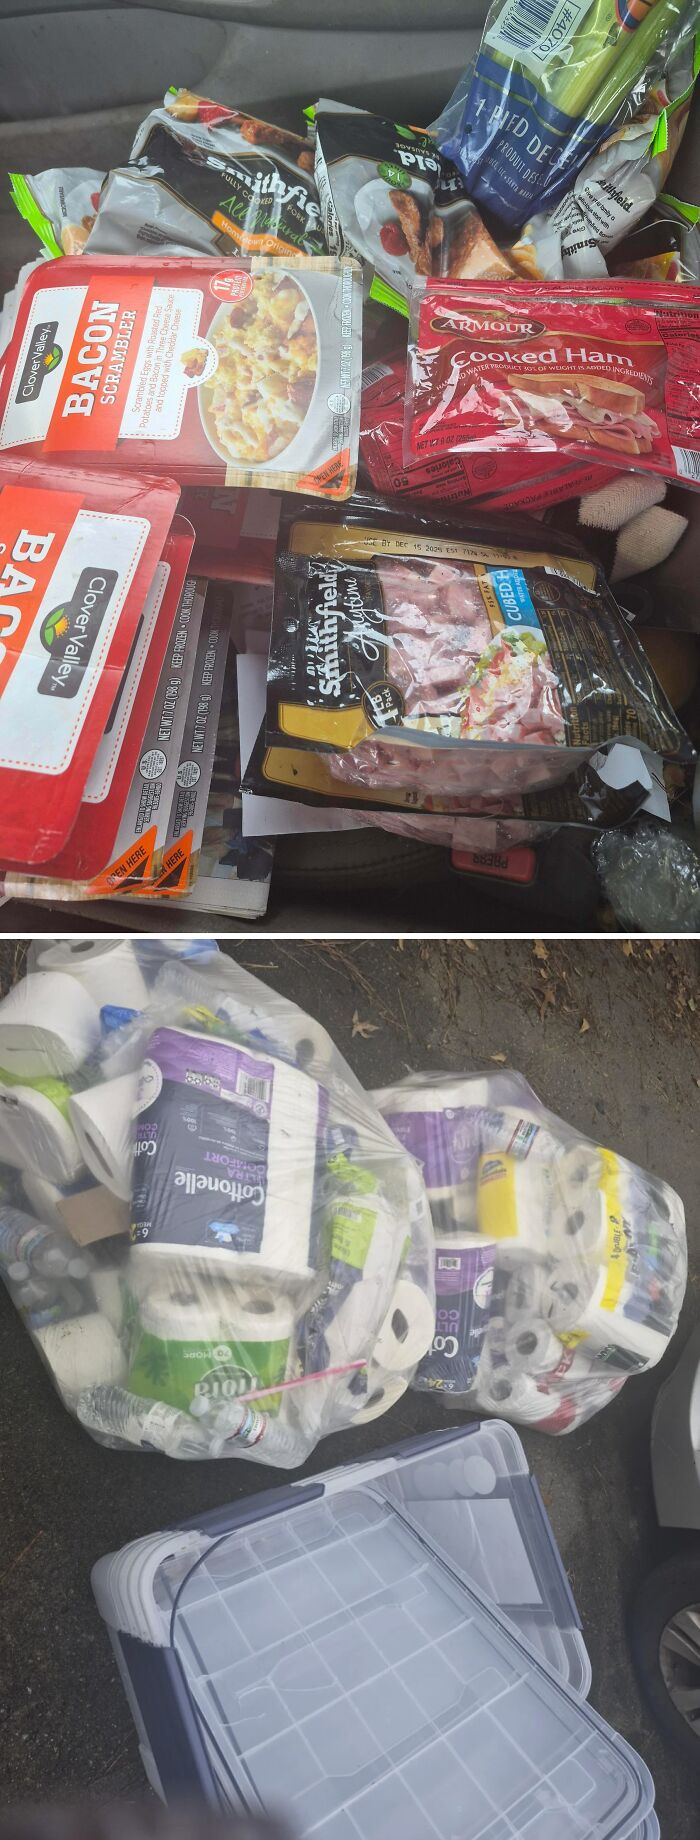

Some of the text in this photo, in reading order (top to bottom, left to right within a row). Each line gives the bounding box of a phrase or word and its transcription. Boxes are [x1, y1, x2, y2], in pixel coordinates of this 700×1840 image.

[538, 8, 573, 52] #4070
[475, 99, 553, 164] 1 PIED DE
[496, 140, 526, 172] PRODUIT
[221, 172, 242, 191] FULLY
[286, 203, 306, 224] PORK
[596, 179, 634, 214] ithfield
[656, 310, 700, 319] Nutrition
[440, 319, 536, 335] ARMOUR
[145, 345, 154, 359] with
[156, 336, 166, 354] Three
[22, 327, 52, 397] CloverValley
[61, 300, 120, 418] BACON
[100, 310, 137, 405] SCRAMBLER
[141, 358, 152, 375] Eggs
[155, 308, 182, 412] and topped with Cheddar Cheese
[450, 347, 634, 370] Cooked Ham
[150, 361, 161, 382] Bacon
[466, 363, 491, 375] WATER
[490, 363, 522, 371] PRODUCT
[611, 366, 654, 386] INGREDIENTS
[132, 376, 148, 413] Scrambled
[147, 382, 156, 396] and
[140, 396, 153, 428] Potatoes
[416, 440, 429, 451] NET
[425, 456, 461, 475] Calories
[393, 477, 409, 489] 50
[381, 539, 391, 547] BY
[395, 541, 409, 549] DEC
[413, 543, 422, 551] 15
[483, 579, 492, 593] FAT
[498, 582, 523, 622] CUBED
[178, 607, 192, 624] COOK
[51, 576, 107, 687] CloverValley
[172, 628, 188, 653] FROZEN
[315, 569, 342, 697] Smithfield
[170, 652, 184, 669] KEEP
[202, 649, 217, 671] FROZEN
[168, 674, 182, 685] g)
[200, 671, 213, 686] KEEP
[165, 684, 180, 700] (198
[198, 692, 212, 702] g)
[381, 687, 394, 709] Pack
[163, 698, 176, 710] OZ
[159, 712, 173, 728] WT
[195, 715, 207, 725] OZ
[570, 705, 581, 747] Nutrition
[157, 727, 171, 741] NET
[193, 728, 205, 741] WT
[191, 742, 204, 753] NET
[106, 846, 147, 886] OPEN HERE
[165, 849, 185, 868] HERE
[472, 852, 509, 869] PRESS
[203, 1151, 266, 1175] COMFORT
[226, 1167, 266, 1186] ULTRA
[174, 1170, 265, 1207] Cottonelle
